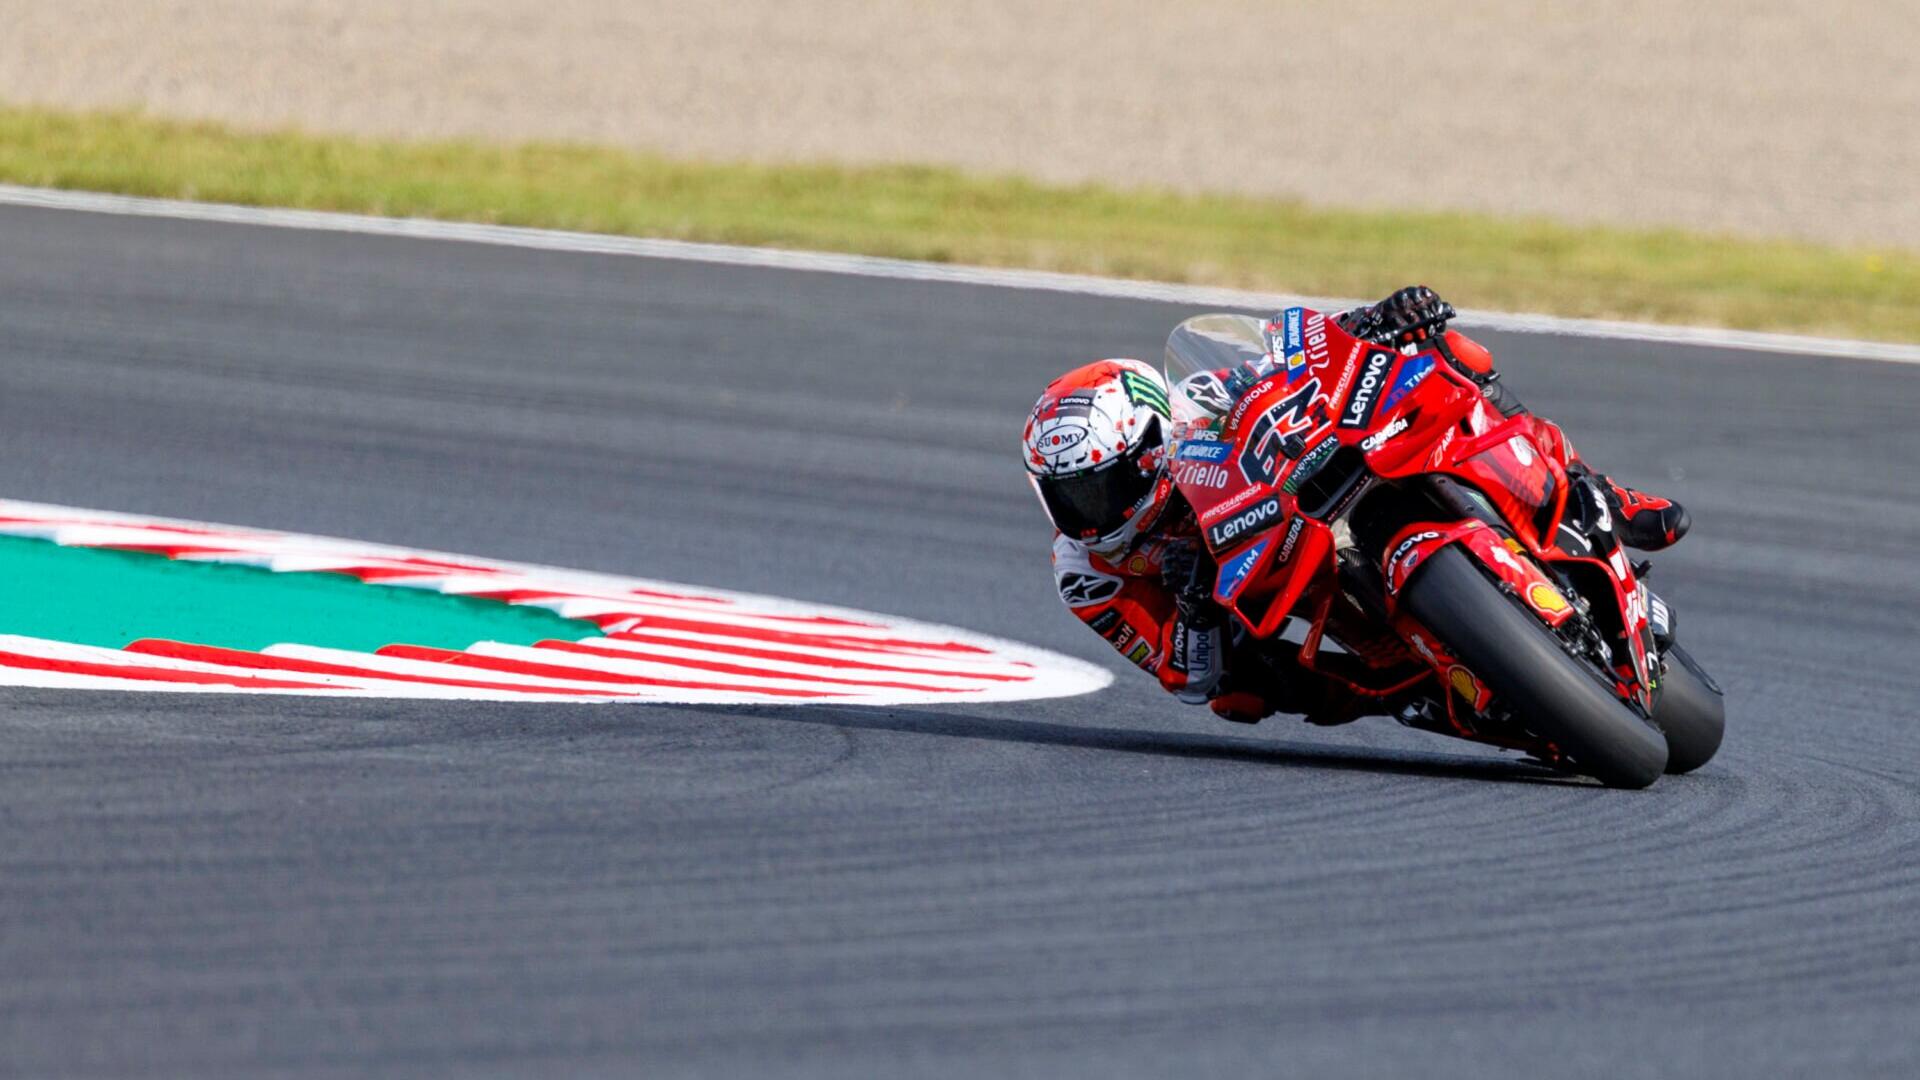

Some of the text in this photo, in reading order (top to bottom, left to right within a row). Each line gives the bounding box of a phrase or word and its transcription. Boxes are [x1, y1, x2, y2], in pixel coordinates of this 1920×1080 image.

[1329, 342, 1362, 410] FRECCIAROSSA
[1342, 353, 1387, 426] Lenovo
[1405, 364, 1435, 389] TIM
[1060, 397, 1090, 405] Lenovo
[1038, 432, 1083, 449] SUOMY
[1292, 436, 1338, 481] MONSTER
[1200, 483, 1262, 521] FRECCIAROSSA
[1212, 500, 1279, 546] Lenovo
[1278, 517, 1305, 563] CARRERA
[1236, 549, 1260, 580] TIM
[1387, 531, 1440, 596] Lenovo
[1190, 633, 1210, 672] Unipo
